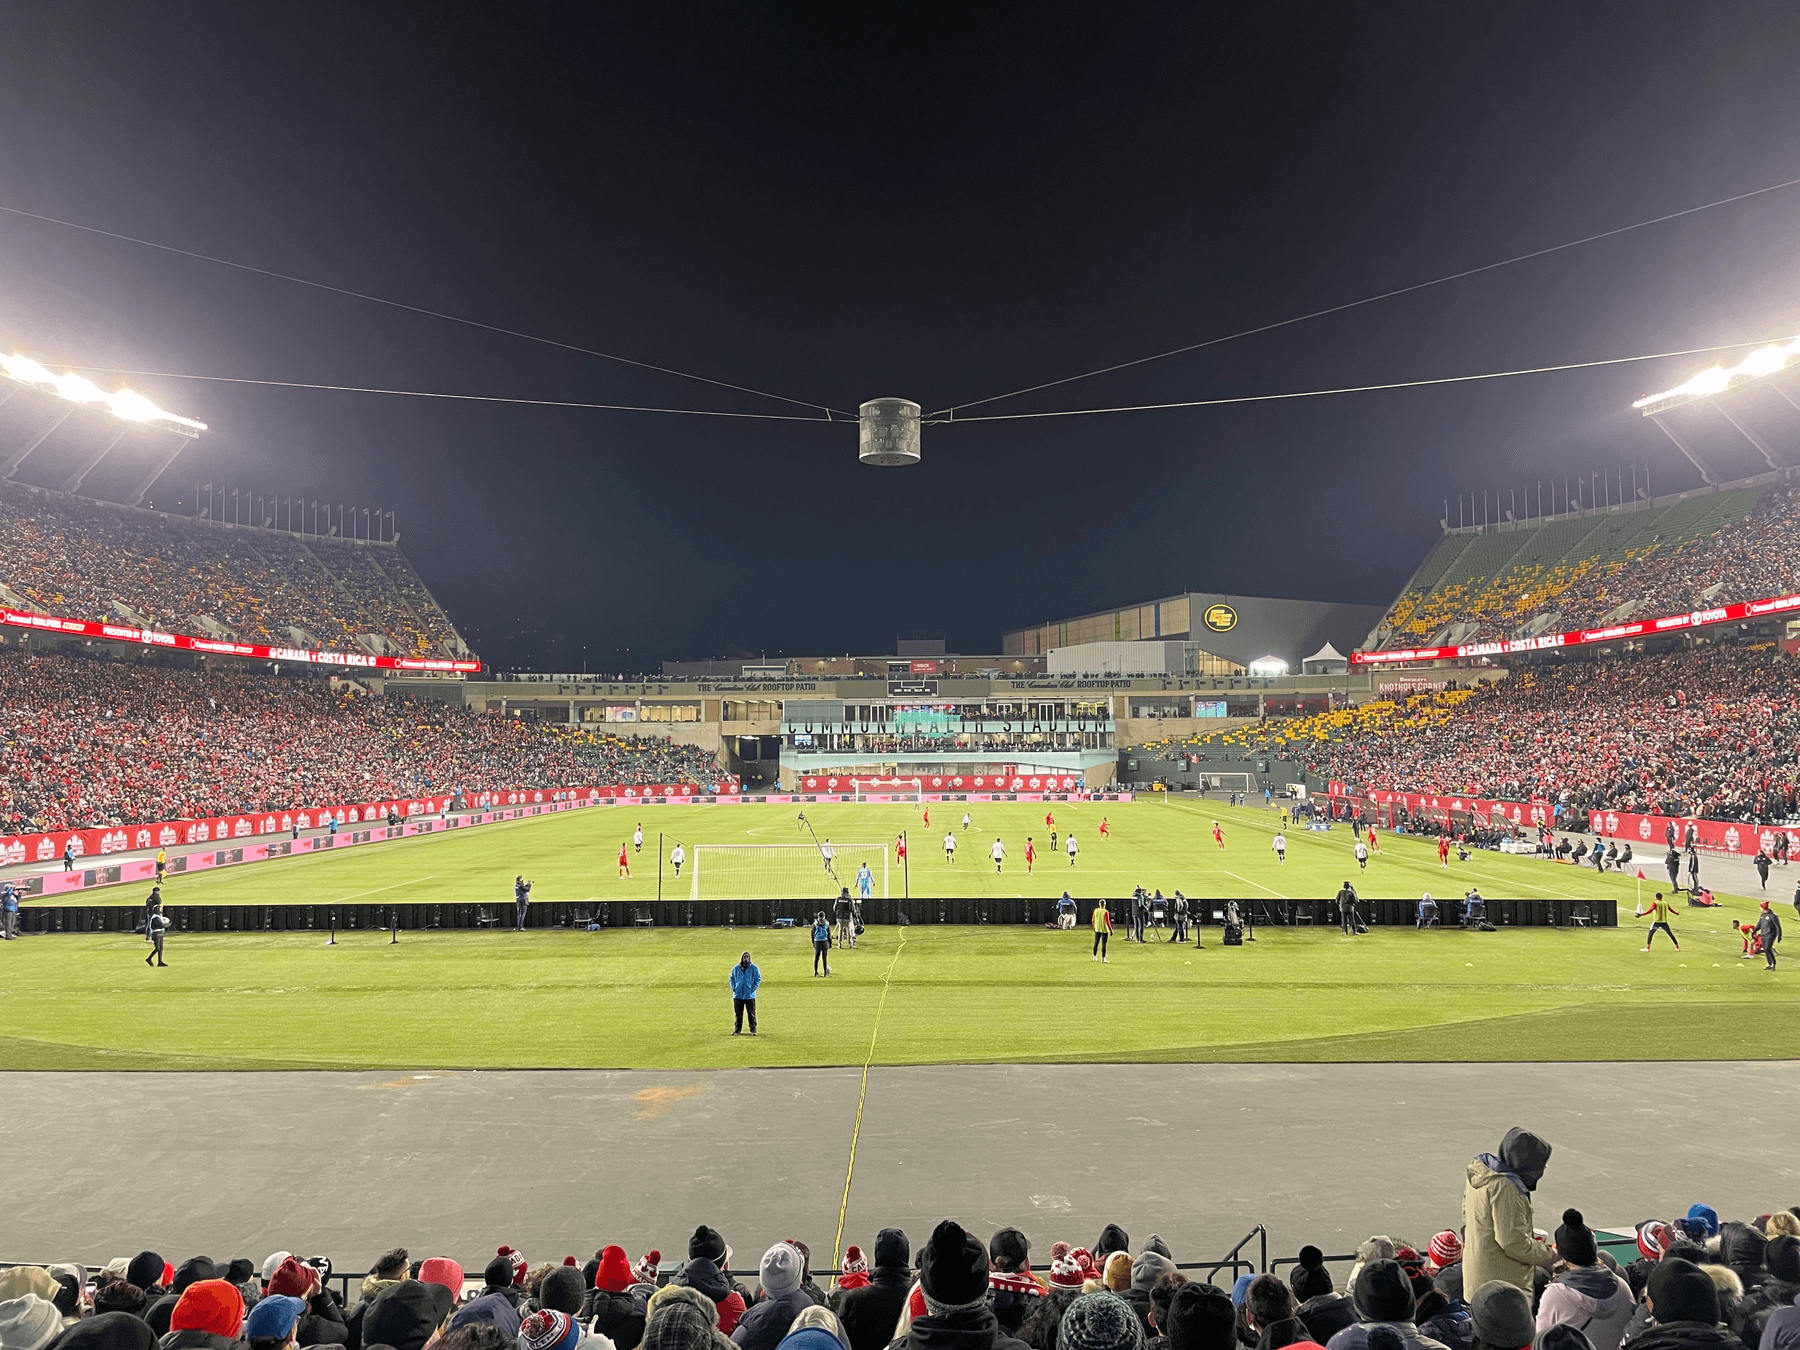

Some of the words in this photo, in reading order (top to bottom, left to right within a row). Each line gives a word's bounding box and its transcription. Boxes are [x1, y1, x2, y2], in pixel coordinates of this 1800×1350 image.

[1656, 617, 1682, 629] PRESENTED
[1702, 609, 1727, 622] TOYOTA
[103, 627, 133, 638] PRESENTED
[133, 631, 140, 639] BY
[152, 635, 176, 645] TOYOTA
[1467, 642, 1503, 656] CANADA
[1509, 639, 1538, 652] COSTA
[1538, 635, 1557, 648] RICA
[277, 648, 311, 662] CANADA
[317, 652, 344, 664] COSTA
[346, 654, 367, 666] RICA
[697, 683, 712, 692] THE
[762, 683, 795, 691] ROOFTOP
[795, 683, 816, 691] PATIO
[1011, 681, 1025, 689] THE
[1077, 680, 1110, 688] ROOFTOP
[1110, 680, 1131, 688] PATIO
[788, 718, 983, 734] COMMONWEALTH
[1003, 716, 1106, 733] STADIUM
